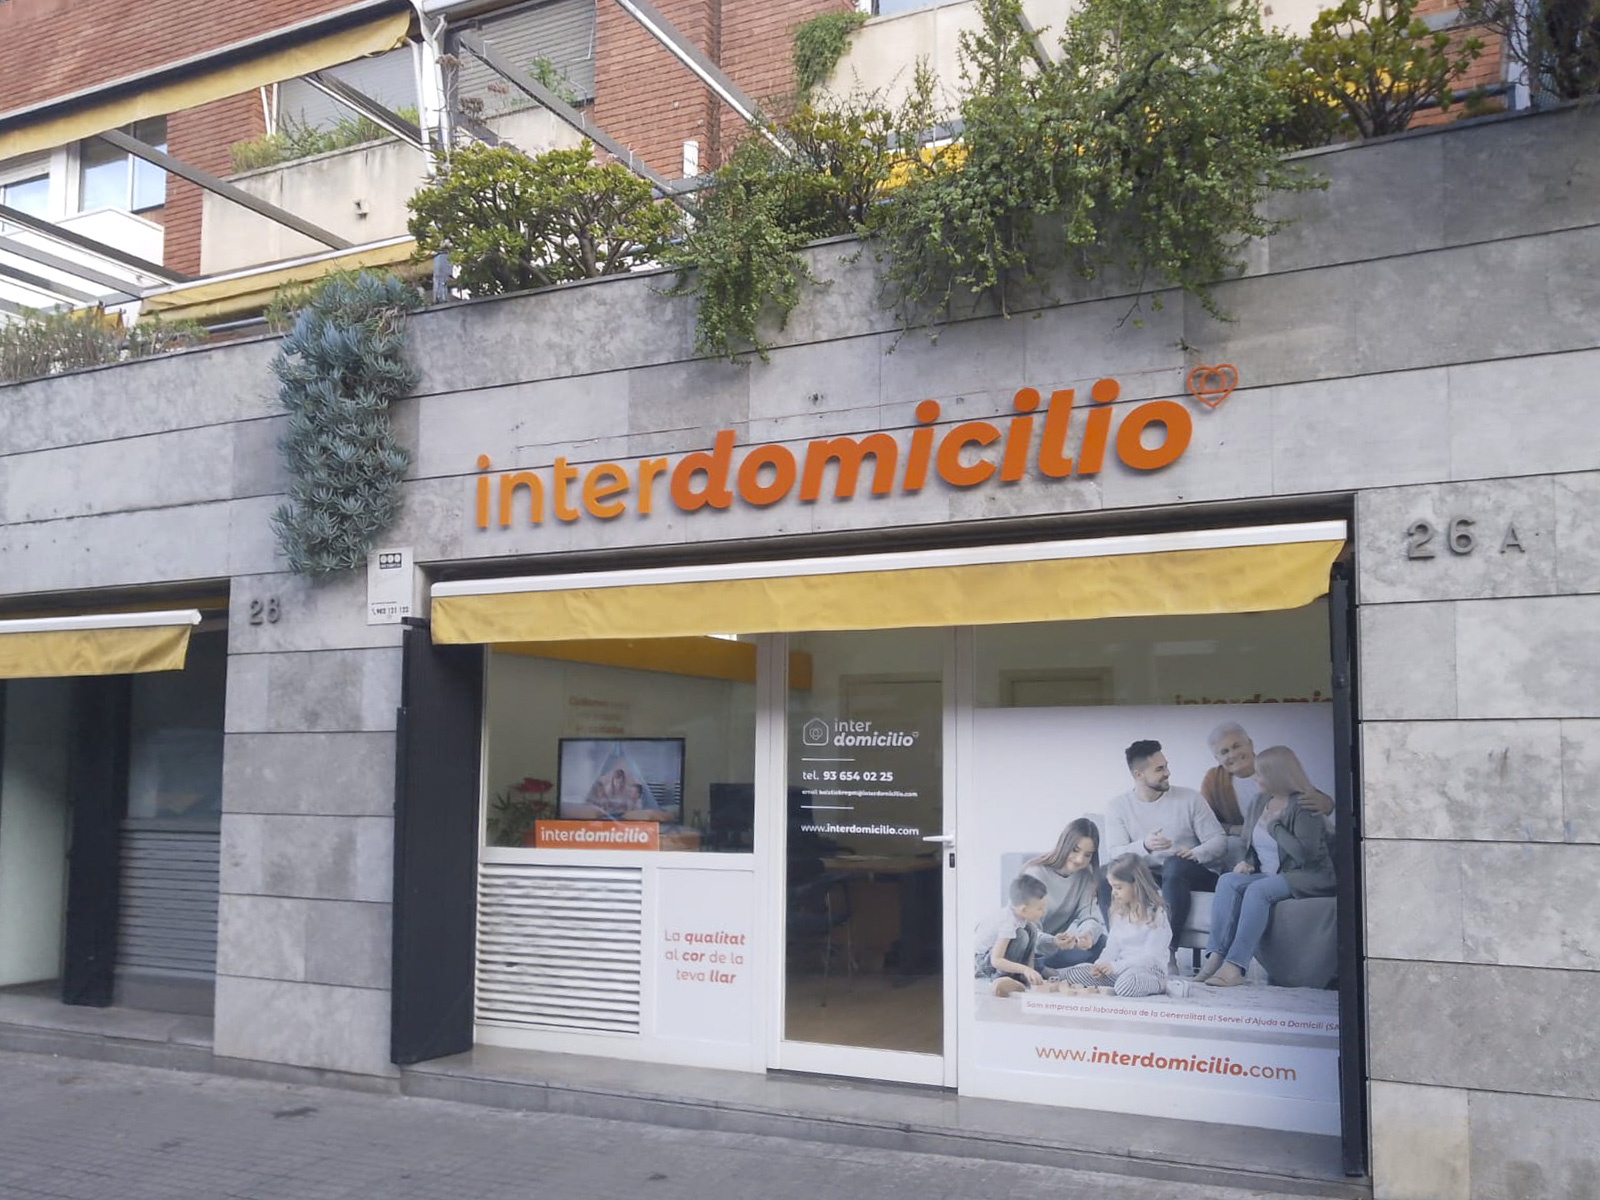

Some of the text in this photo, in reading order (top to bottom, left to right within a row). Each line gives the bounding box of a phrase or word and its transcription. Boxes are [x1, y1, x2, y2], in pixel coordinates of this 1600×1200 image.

[475, 378, 1193, 529] interdomicilio
[1406, 515, 1527, 561] 26 A
[249, 596, 281, 626] 28
[834, 718, 872, 733] inter
[833, 731, 914, 747] domicilio
[802, 770, 894, 782] tel. 93 654 02 25
[541, 827, 649, 843] interdomicilio
[800, 822, 920, 836] www.interdomicilio.com
[664, 929, 746, 946] La qualitat
[665, 949, 744, 965] al cor de la
[676, 968, 736, 984] teva llar
[1139, 1009, 1149, 1017] de
[1151, 1010, 1158, 1018] la
[1160, 1011, 1206, 1021] Generalitat
[1208, 1014, 1216, 1022] al
[1217, 1014, 1243, 1024] Servei
[1288, 1020, 1324, 1030] Domicili
[1035, 1046, 1297, 1082] www.interdomicilio.com
